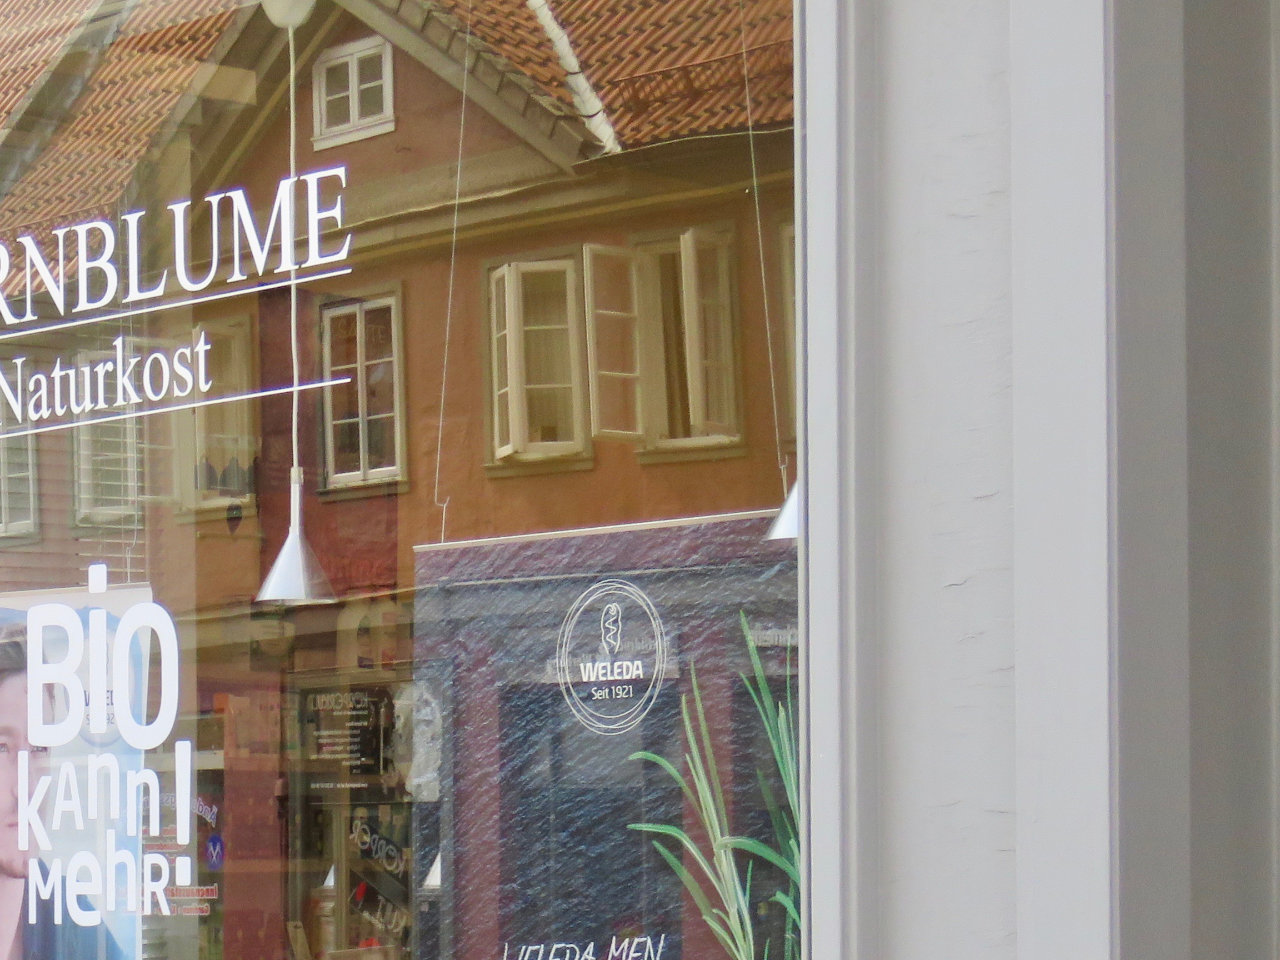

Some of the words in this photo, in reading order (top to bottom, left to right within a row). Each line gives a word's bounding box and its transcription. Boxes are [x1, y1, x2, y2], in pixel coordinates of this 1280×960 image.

[579, 660, 644, 682] WELEDA
[591, 687, 610, 700] Seit
[611, 685, 633, 698] 1921
